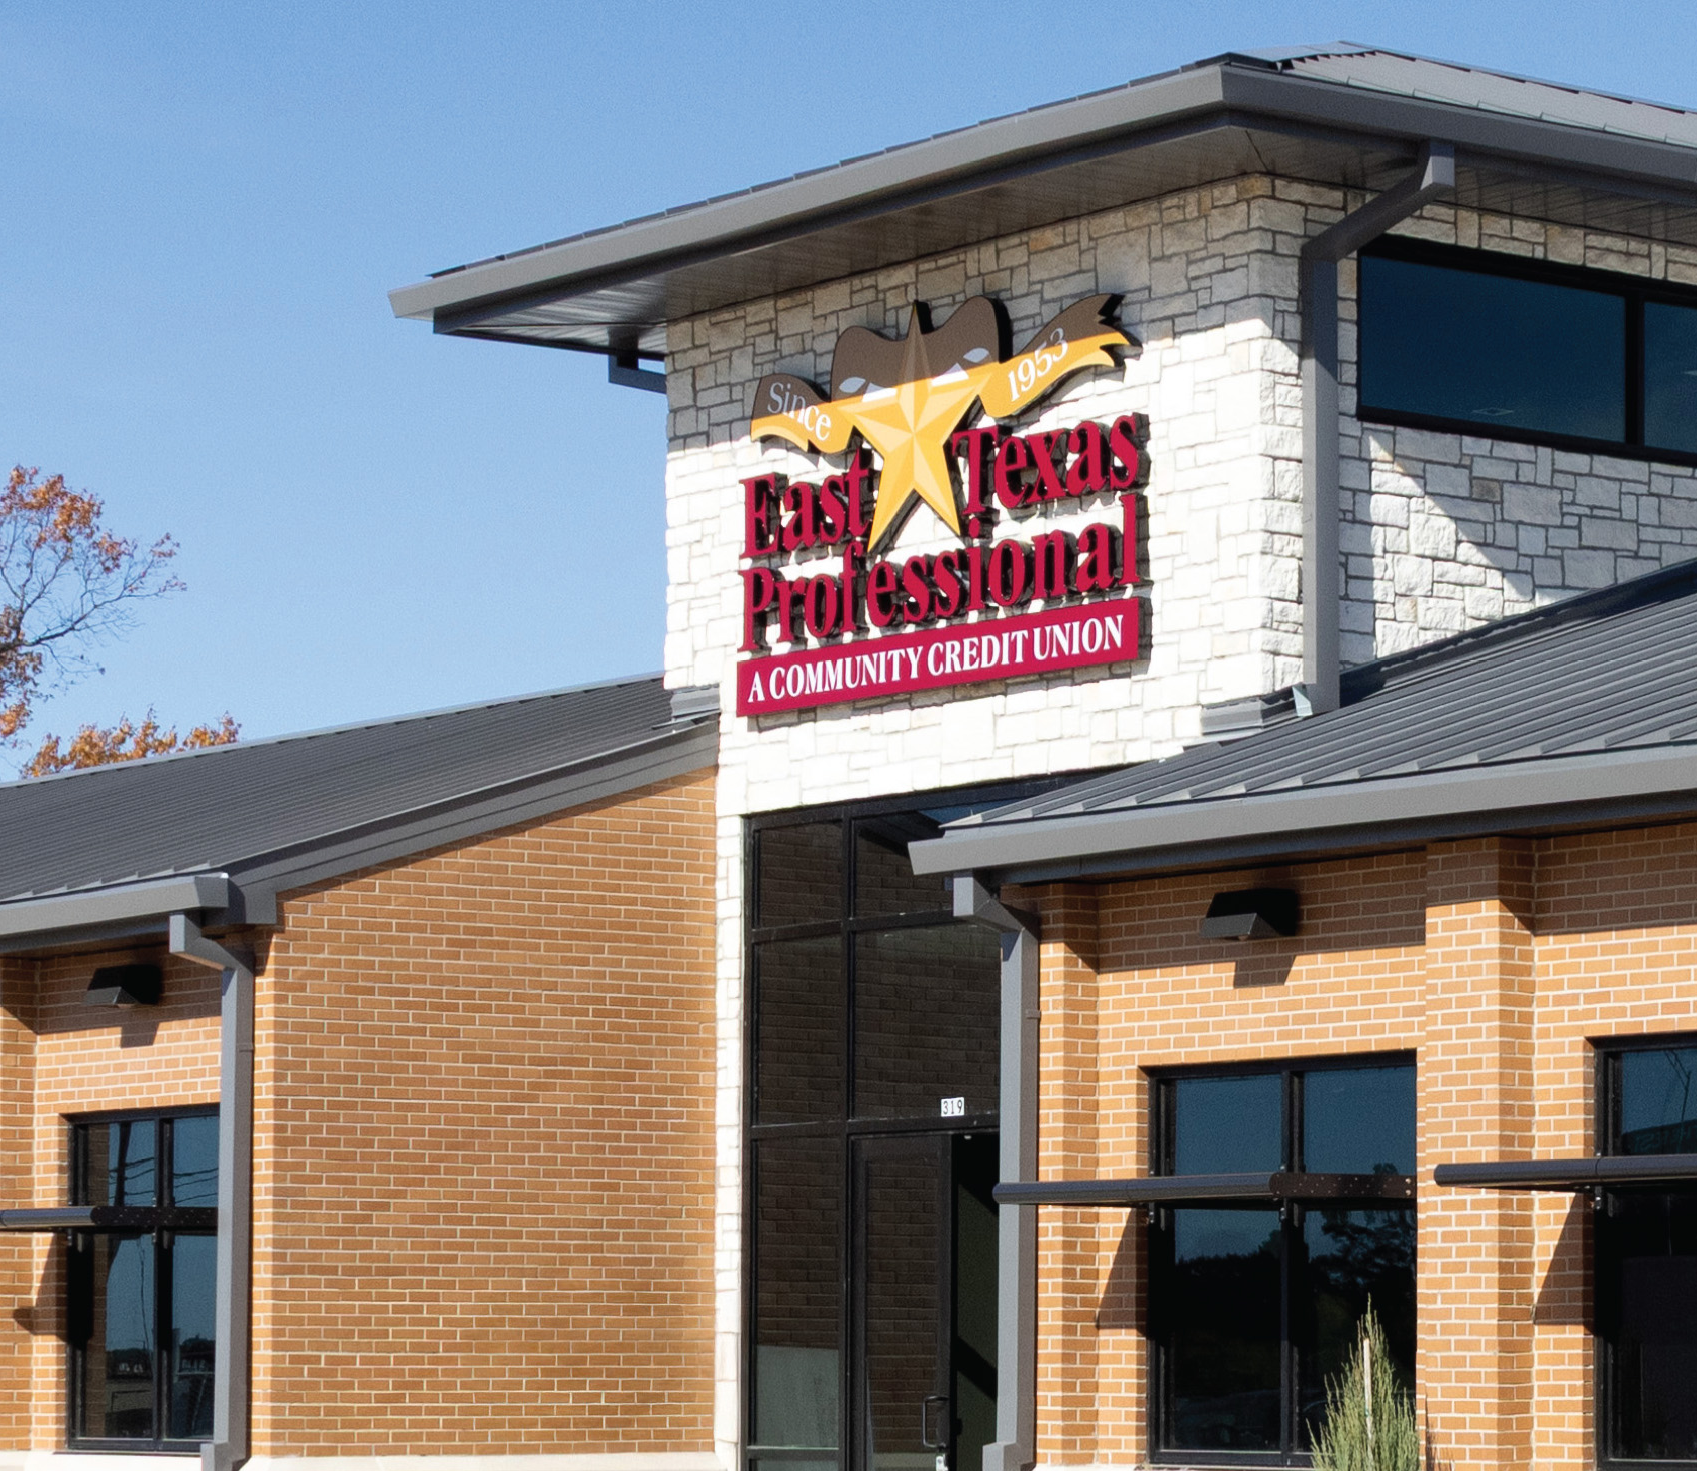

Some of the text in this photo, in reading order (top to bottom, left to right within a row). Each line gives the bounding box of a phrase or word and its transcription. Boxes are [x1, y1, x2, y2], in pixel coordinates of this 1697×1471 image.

[767, 327, 1068, 441] Since 1953
[739, 414, 1139, 558] East Texas
[738, 495, 1140, 651] Professional
[748, 614, 1125, 703] A COMMUNITY CREDIT UNION
[943, 1099, 963, 1115] 319
